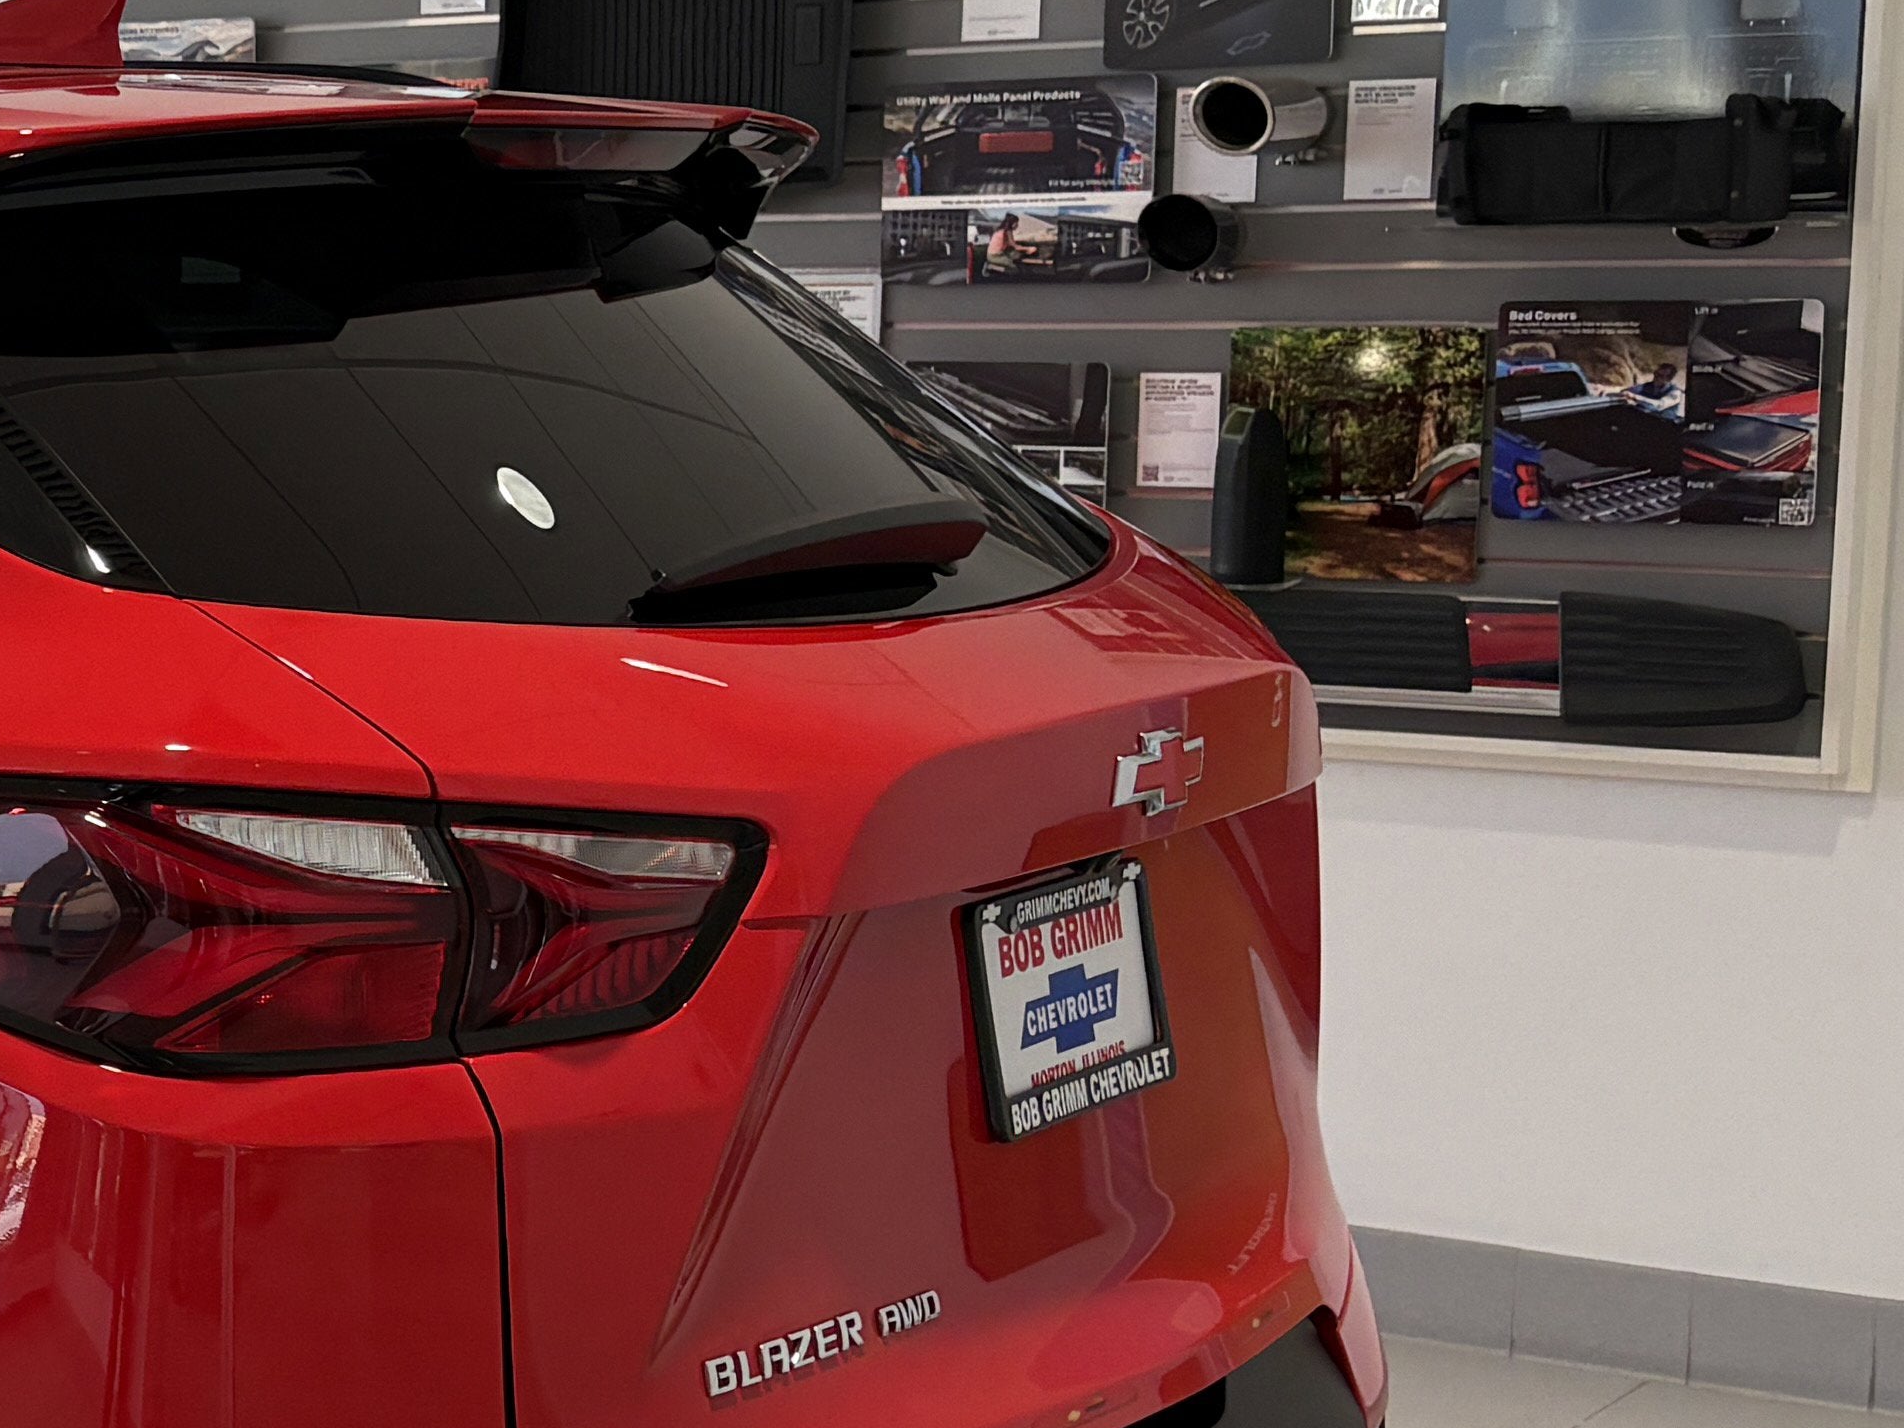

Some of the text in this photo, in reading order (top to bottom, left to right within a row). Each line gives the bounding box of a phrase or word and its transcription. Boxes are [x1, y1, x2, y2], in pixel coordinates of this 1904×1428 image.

[896, 96, 927, 107] Utility
[929, 95, 951, 106] Wall
[952, 93, 971, 104] and
[1003, 91, 1032, 102] Panel
[1033, 89, 1082, 101] Products
[1508, 310, 1578, 321] Bed Covers
[1016, 876, 1111, 924] GRIMMCHEVY.COM
[997, 899, 1124, 979] BOB GRIMM
[1025, 983, 1114, 1037] CHEVROLET
[1010, 1046, 1172, 1137] BOB GRIMM CHEVROLET
[704, 1290, 942, 1398] BLAZER AWD
